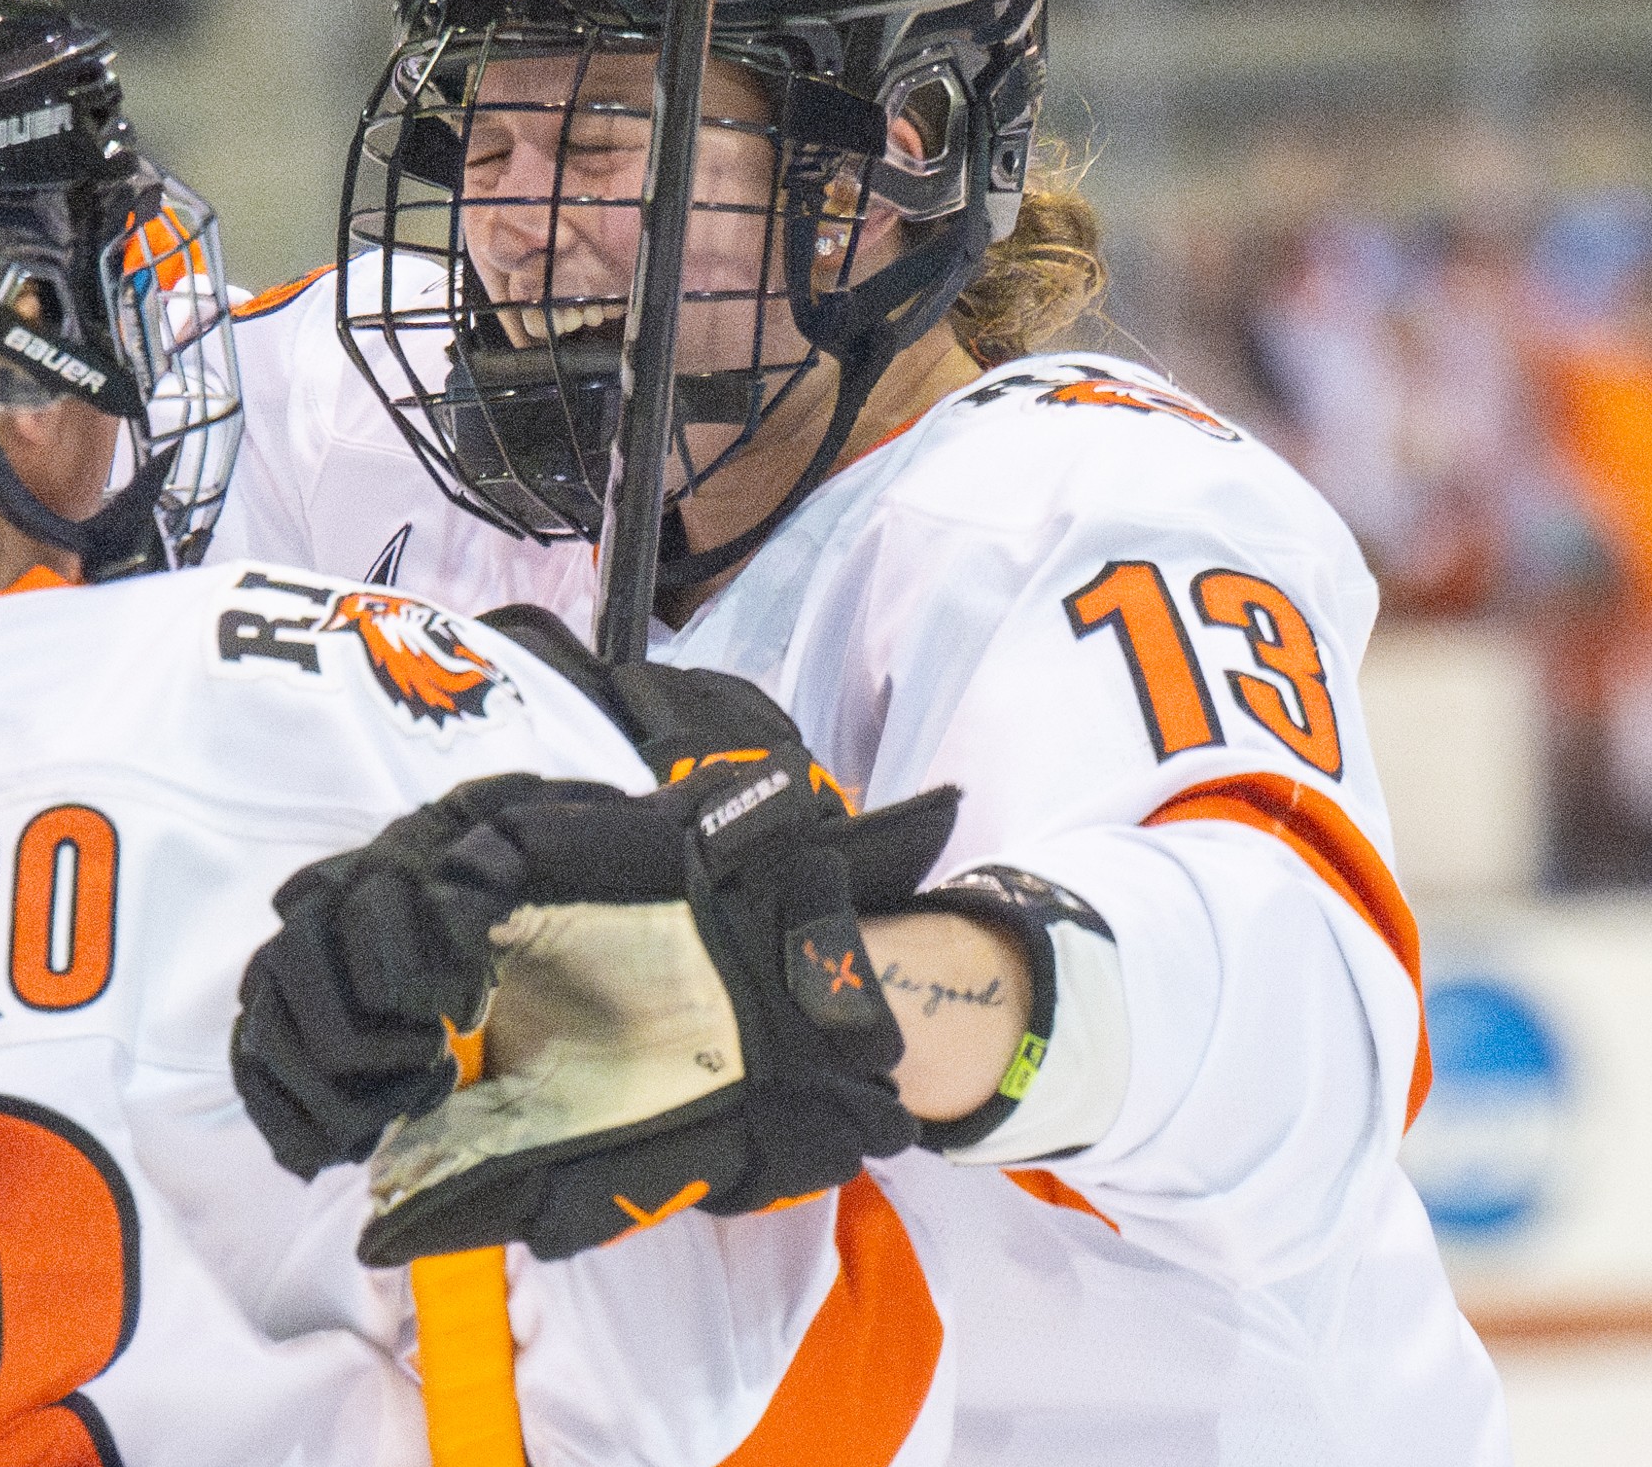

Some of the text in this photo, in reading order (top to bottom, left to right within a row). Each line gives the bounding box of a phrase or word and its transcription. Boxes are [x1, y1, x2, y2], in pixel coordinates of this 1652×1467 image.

[3, 326, 108, 394] BAUER
[1061, 560, 1344, 784] 13
[699, 769, 791, 837] TIGERS
